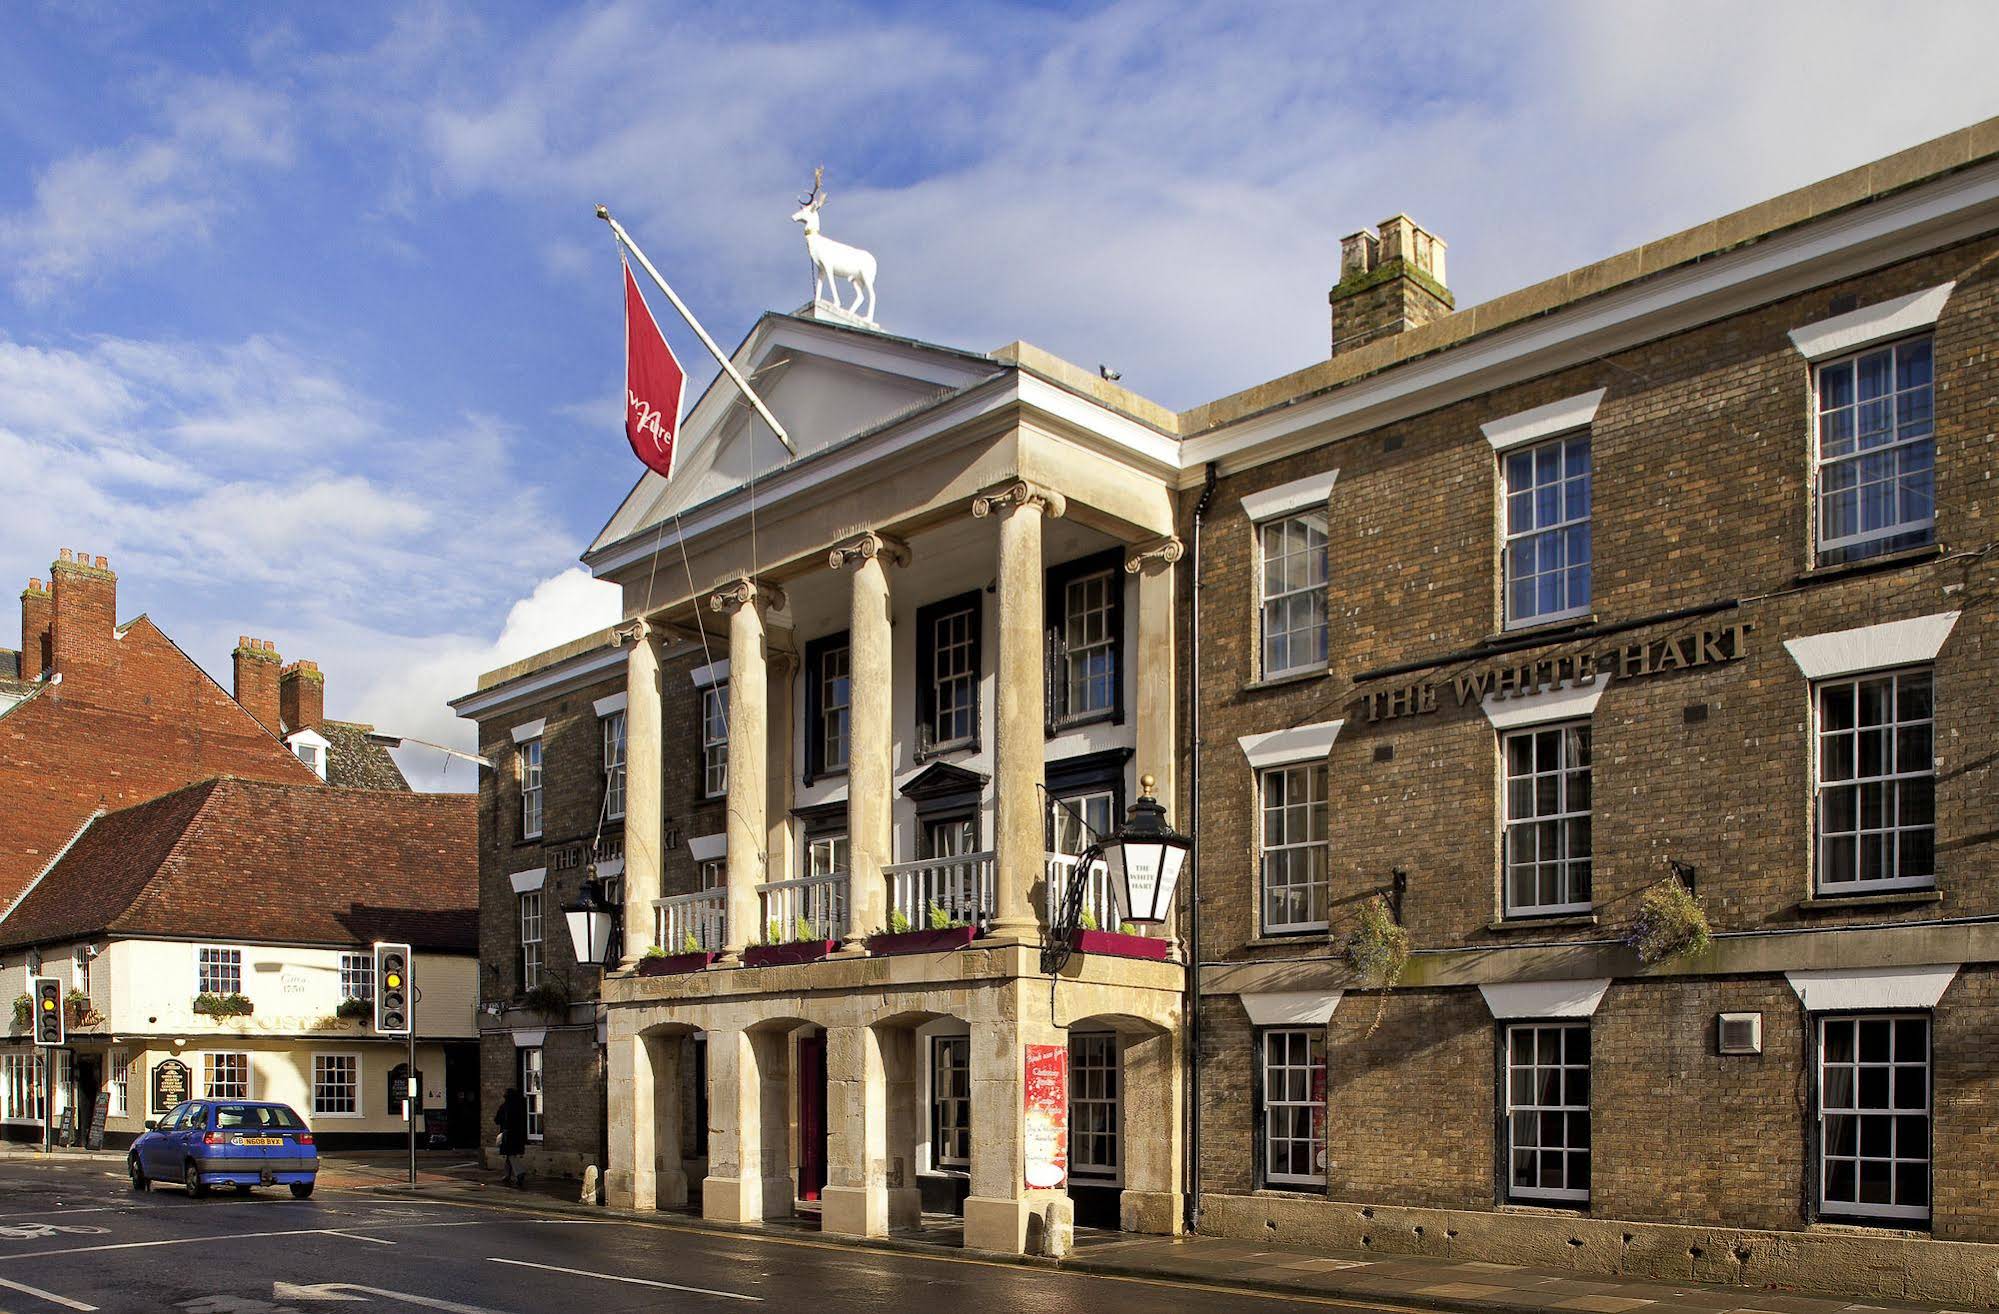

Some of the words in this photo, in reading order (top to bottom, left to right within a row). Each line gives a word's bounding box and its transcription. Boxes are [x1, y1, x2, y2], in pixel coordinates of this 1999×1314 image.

[1361, 683, 1437, 722] THE
[1453, 652, 1598, 707] WHITE
[1617, 619, 1757, 680] HART
[551, 848, 578, 870] THE
